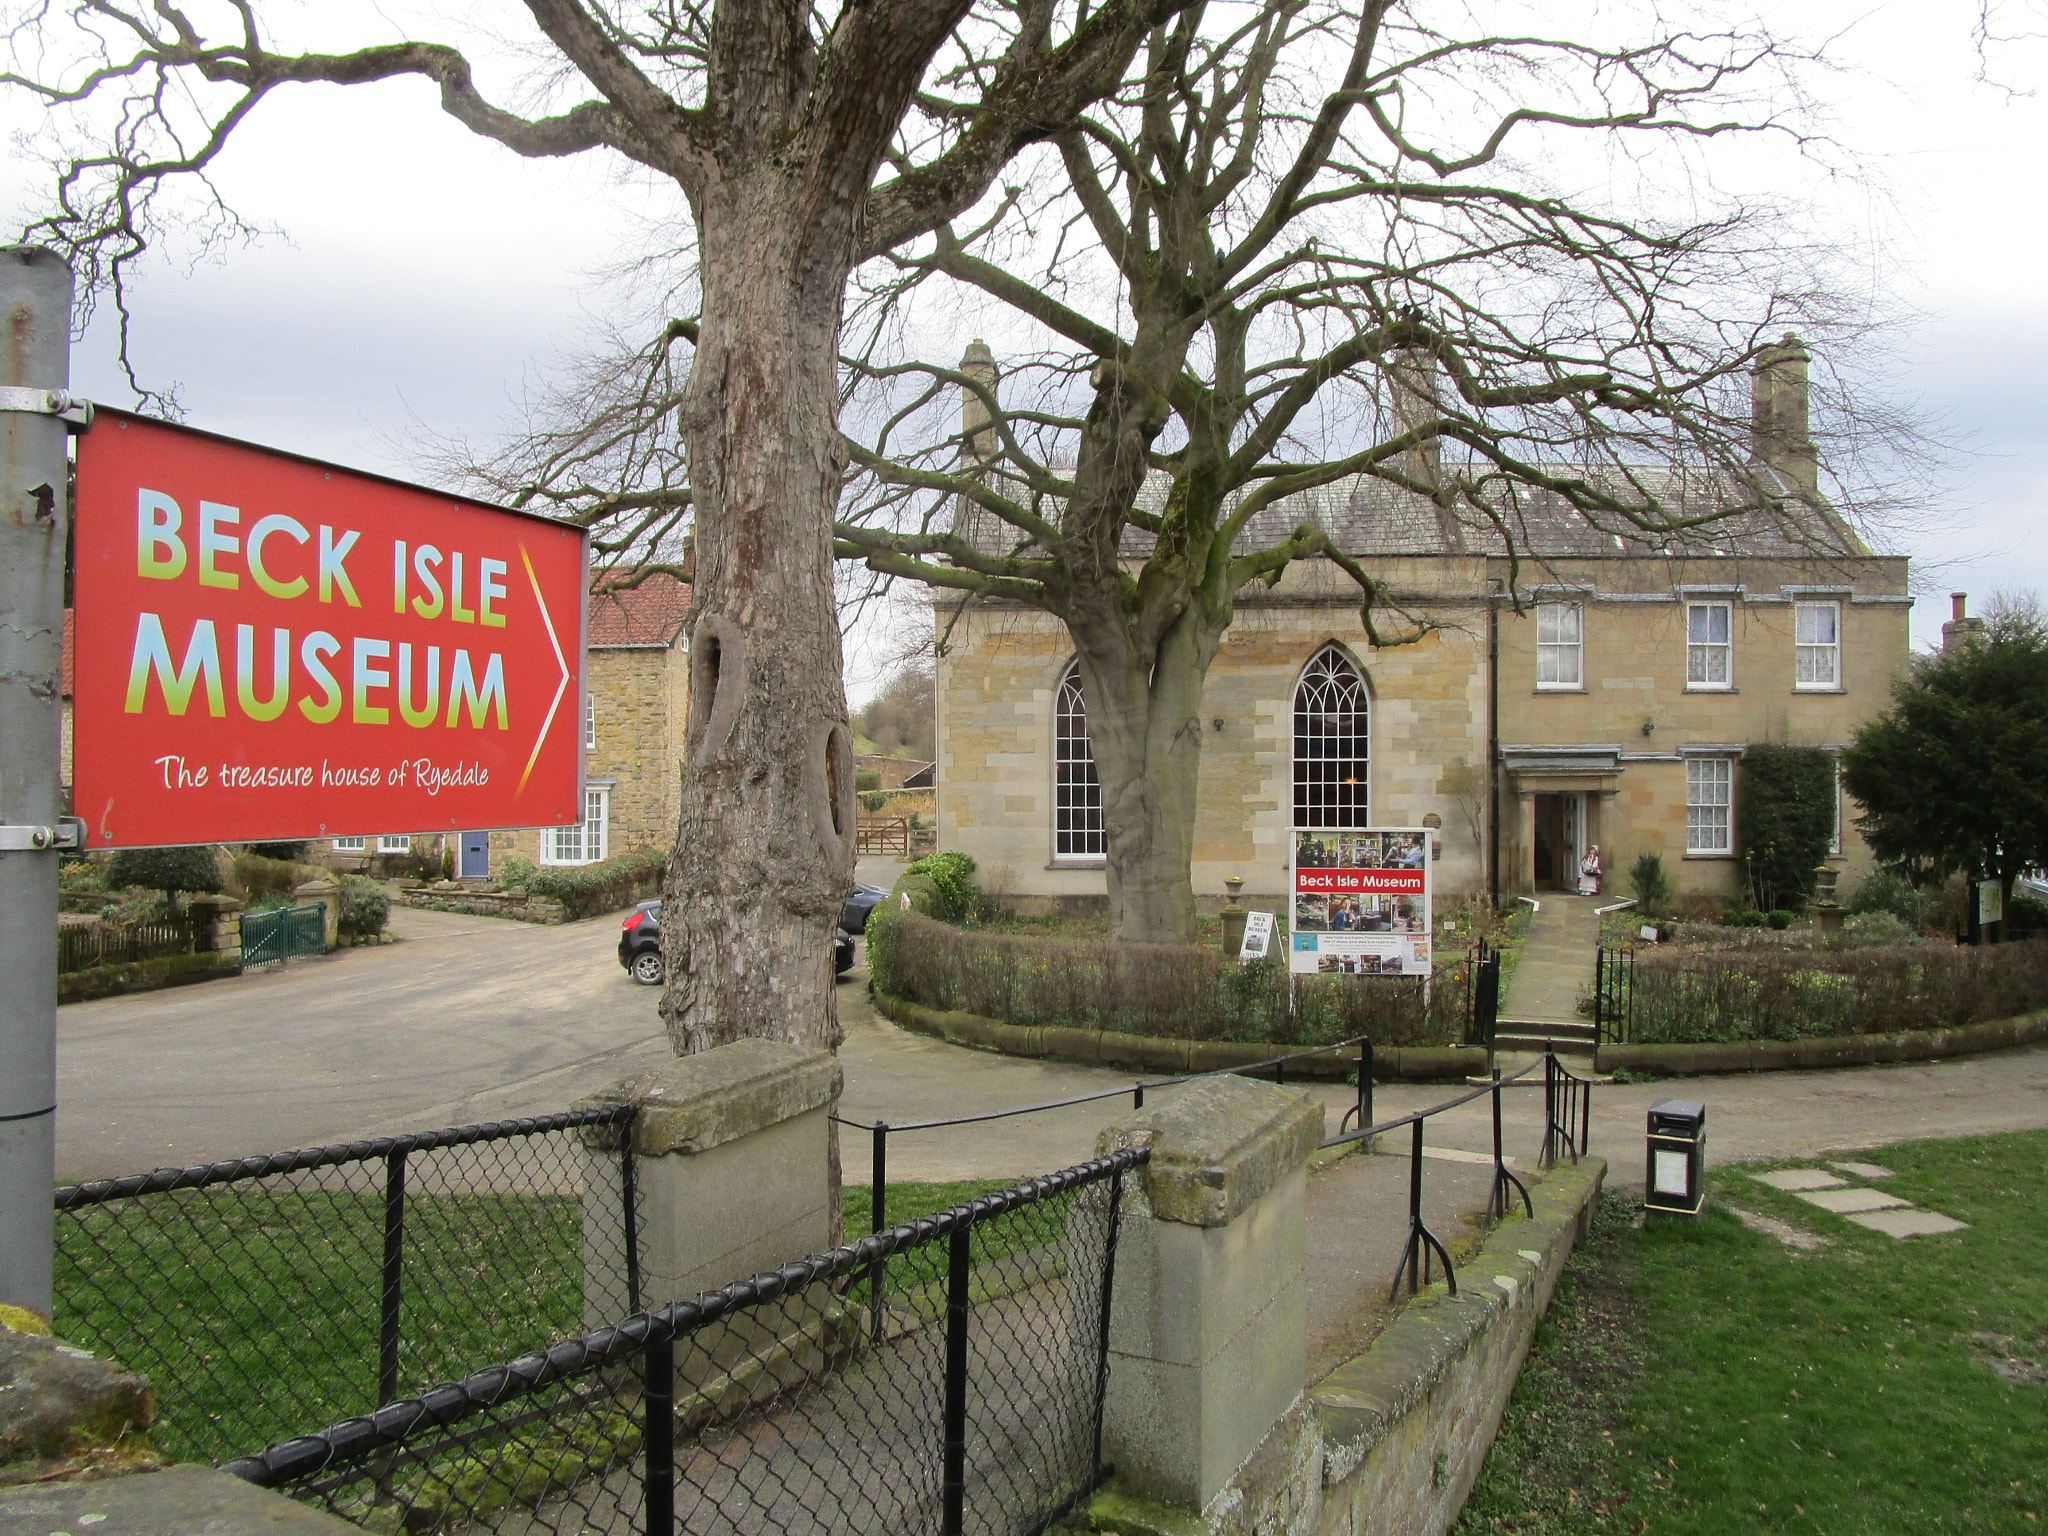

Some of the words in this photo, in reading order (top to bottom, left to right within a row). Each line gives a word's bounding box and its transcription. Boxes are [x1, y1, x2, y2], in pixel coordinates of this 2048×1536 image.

[138, 487, 361, 607] BECK
[395, 540, 507, 628] ISLE
[124, 612, 509, 730] MUSEUM
[155, 755, 208, 788] The
[219, 763, 313, 787] treasure
[321, 759, 381, 787] house
[388, 760, 408, 785] of
[413, 758, 489, 796] Ryedale
[1300, 875, 1333, 886] Beck
[1337, 875, 1359, 887] Isle
[1363, 876, 1420, 888] Museum
